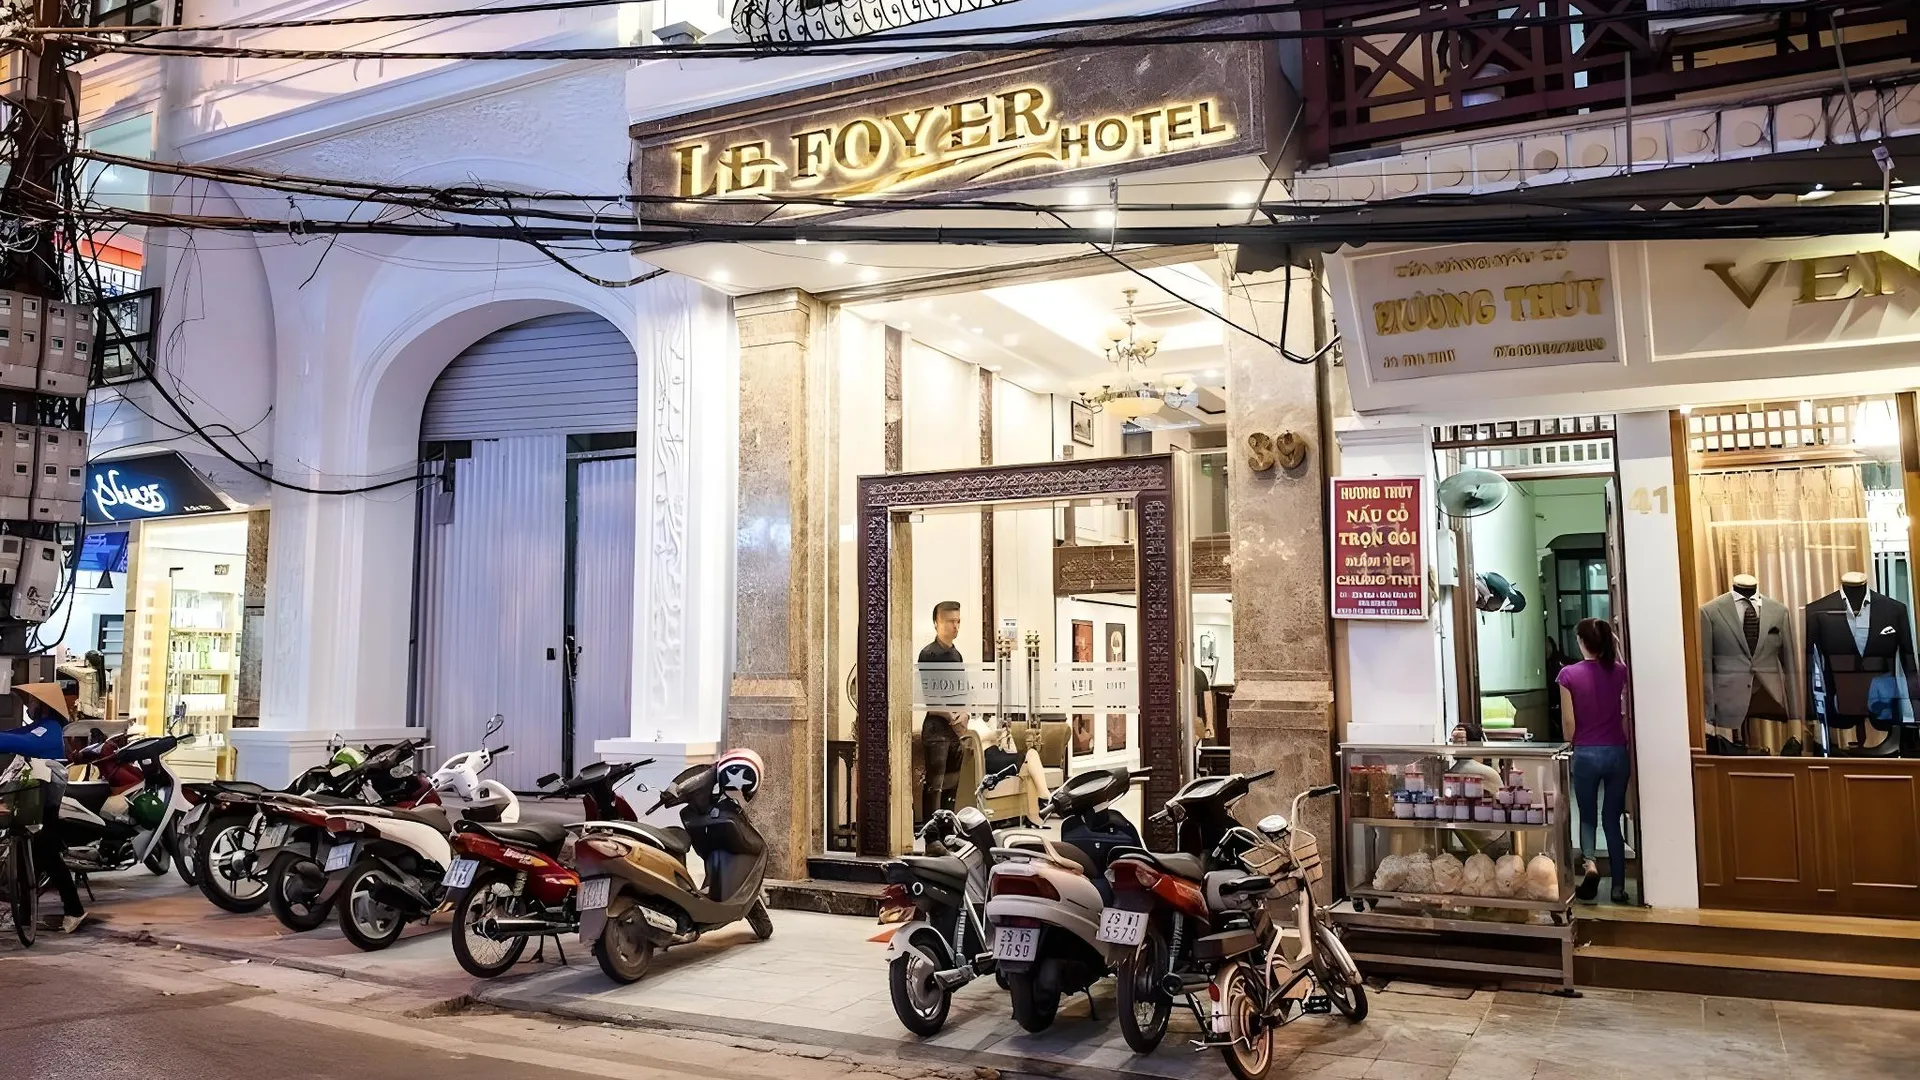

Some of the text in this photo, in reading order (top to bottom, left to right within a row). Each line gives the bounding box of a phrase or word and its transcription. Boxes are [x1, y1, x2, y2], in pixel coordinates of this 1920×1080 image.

[674, 87, 1227, 198] LE FOYER HOTEL
[1247, 432, 1307, 472] 39
[1627, 486, 1669, 514] 41
